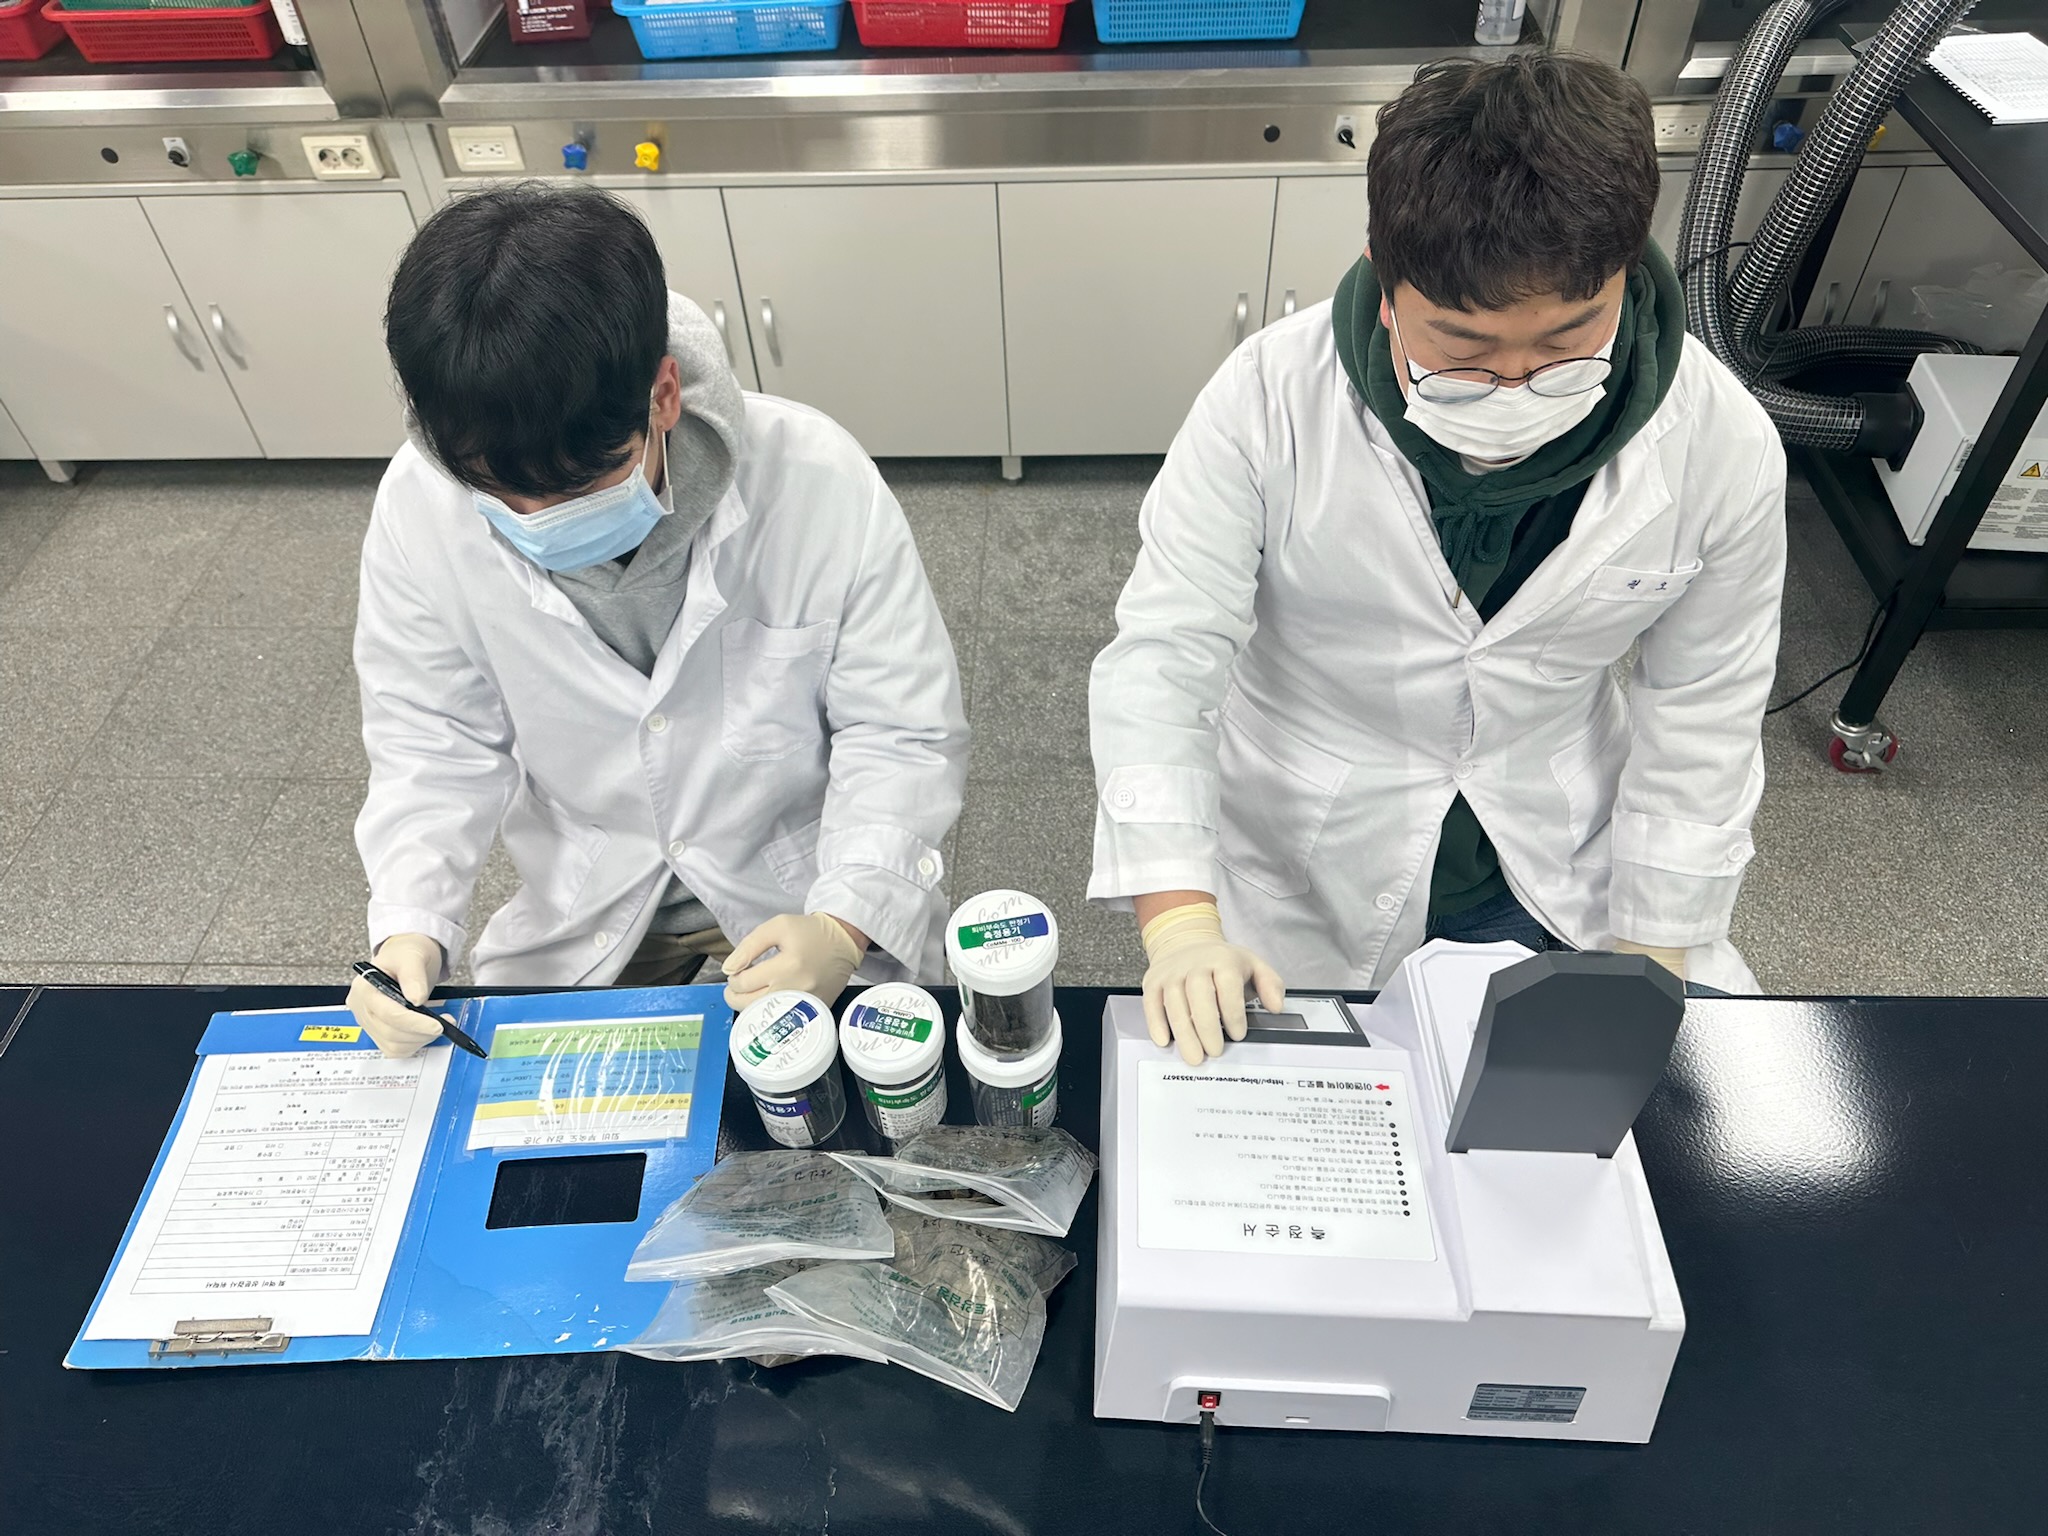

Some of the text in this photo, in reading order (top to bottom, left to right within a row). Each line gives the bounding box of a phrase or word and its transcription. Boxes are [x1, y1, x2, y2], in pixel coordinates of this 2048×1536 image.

[1009, 918, 1030, 926] 판정기
[984, 927, 1021, 939] 측정용기
[876, 1015, 908, 1027] 측정용기
[1162, 1075, 1372, 1091] 이앤에이텍 블로그 http://blog.naver.com/3553677
[547, 1134, 564, 1142] 검사
